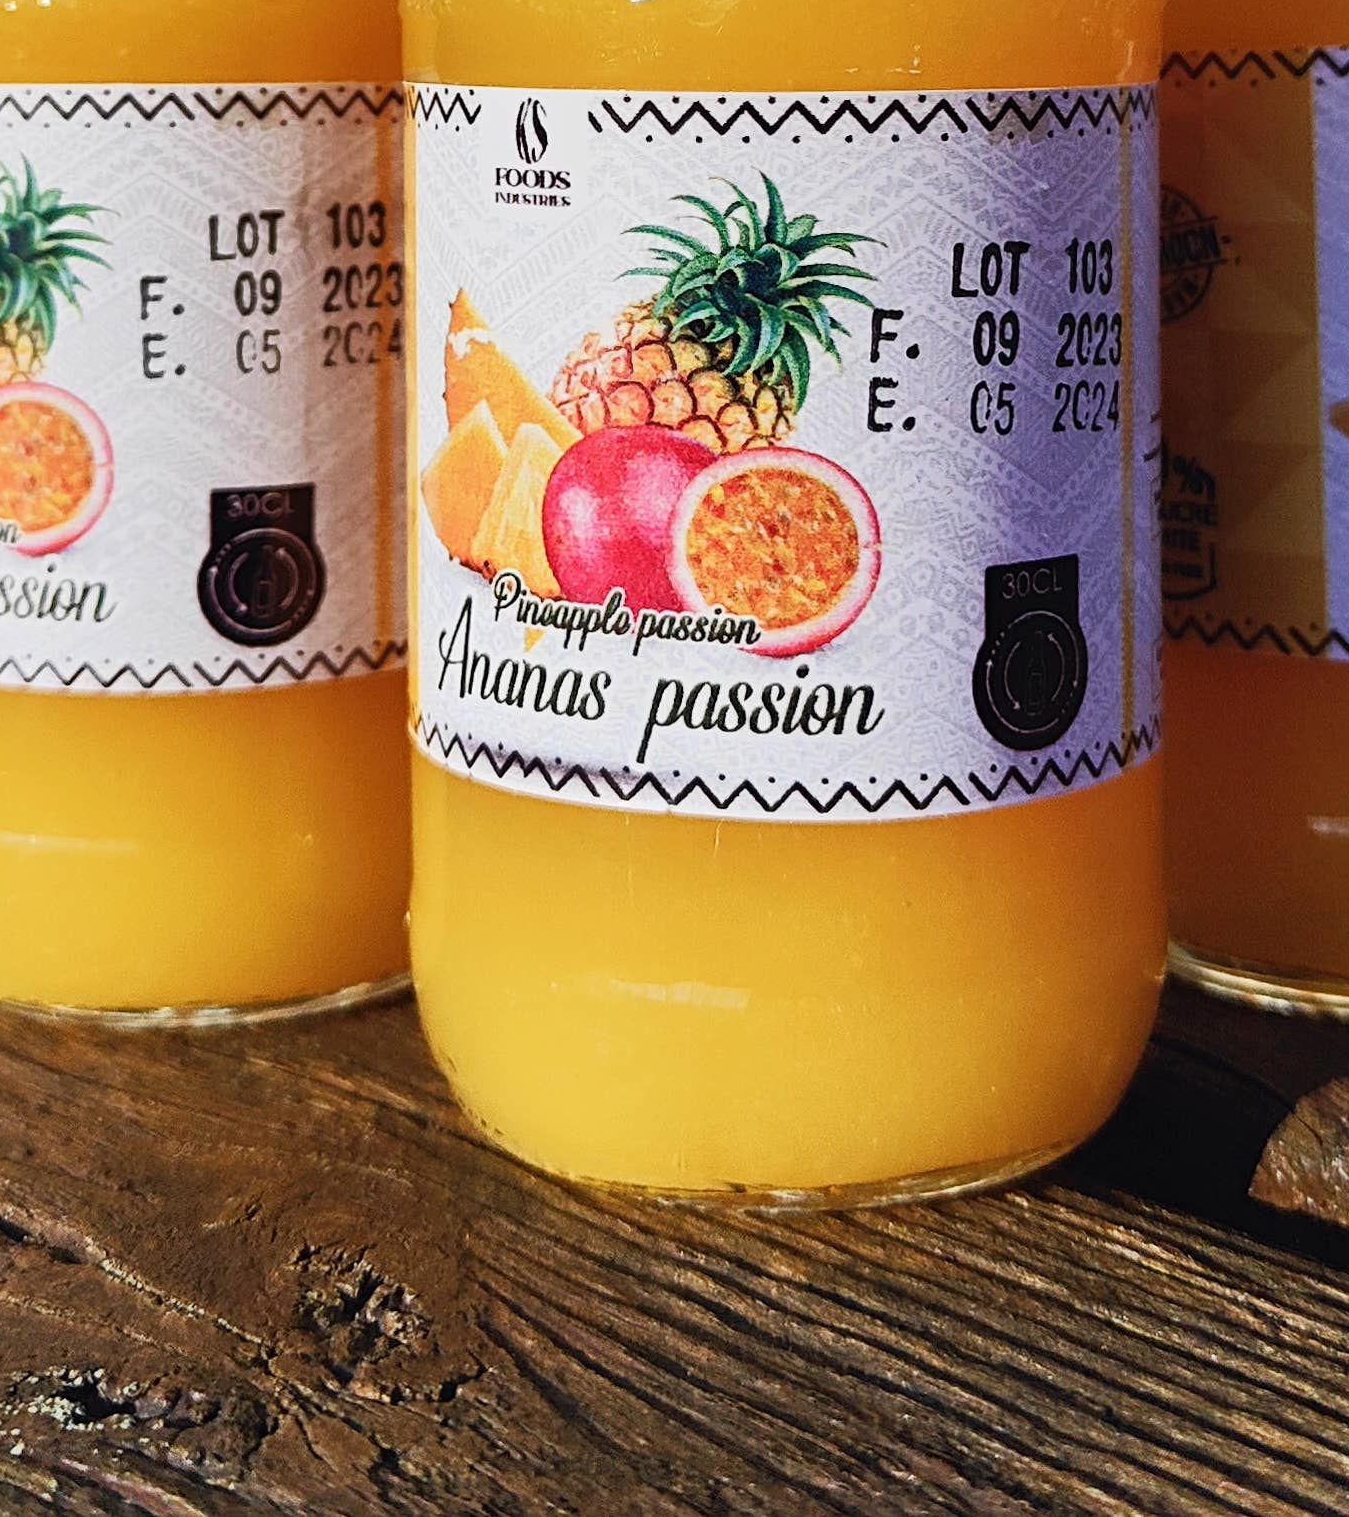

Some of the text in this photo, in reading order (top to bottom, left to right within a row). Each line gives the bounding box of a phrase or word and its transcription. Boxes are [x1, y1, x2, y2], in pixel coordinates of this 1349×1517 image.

[495, 167, 572, 190] FOODS
[495, 192, 572, 207] INDUSTRIES
[208, 200, 387, 261] LOT 103
[140, 260, 403, 320] F. 09 2023
[951, 240, 1031, 298] LOT
[1065, 237, 1114, 295] 103
[141, 333, 187, 379] E.
[236, 329, 282, 374] 05
[869, 308, 1123, 368] F. 09 2023
[866, 376, 1120, 436] E. 05 2024
[1002, 567, 1063, 599] 30CL
[494, 572, 761, 657] Pineapple passion
[438, 594, 885, 764] Ananas passion
